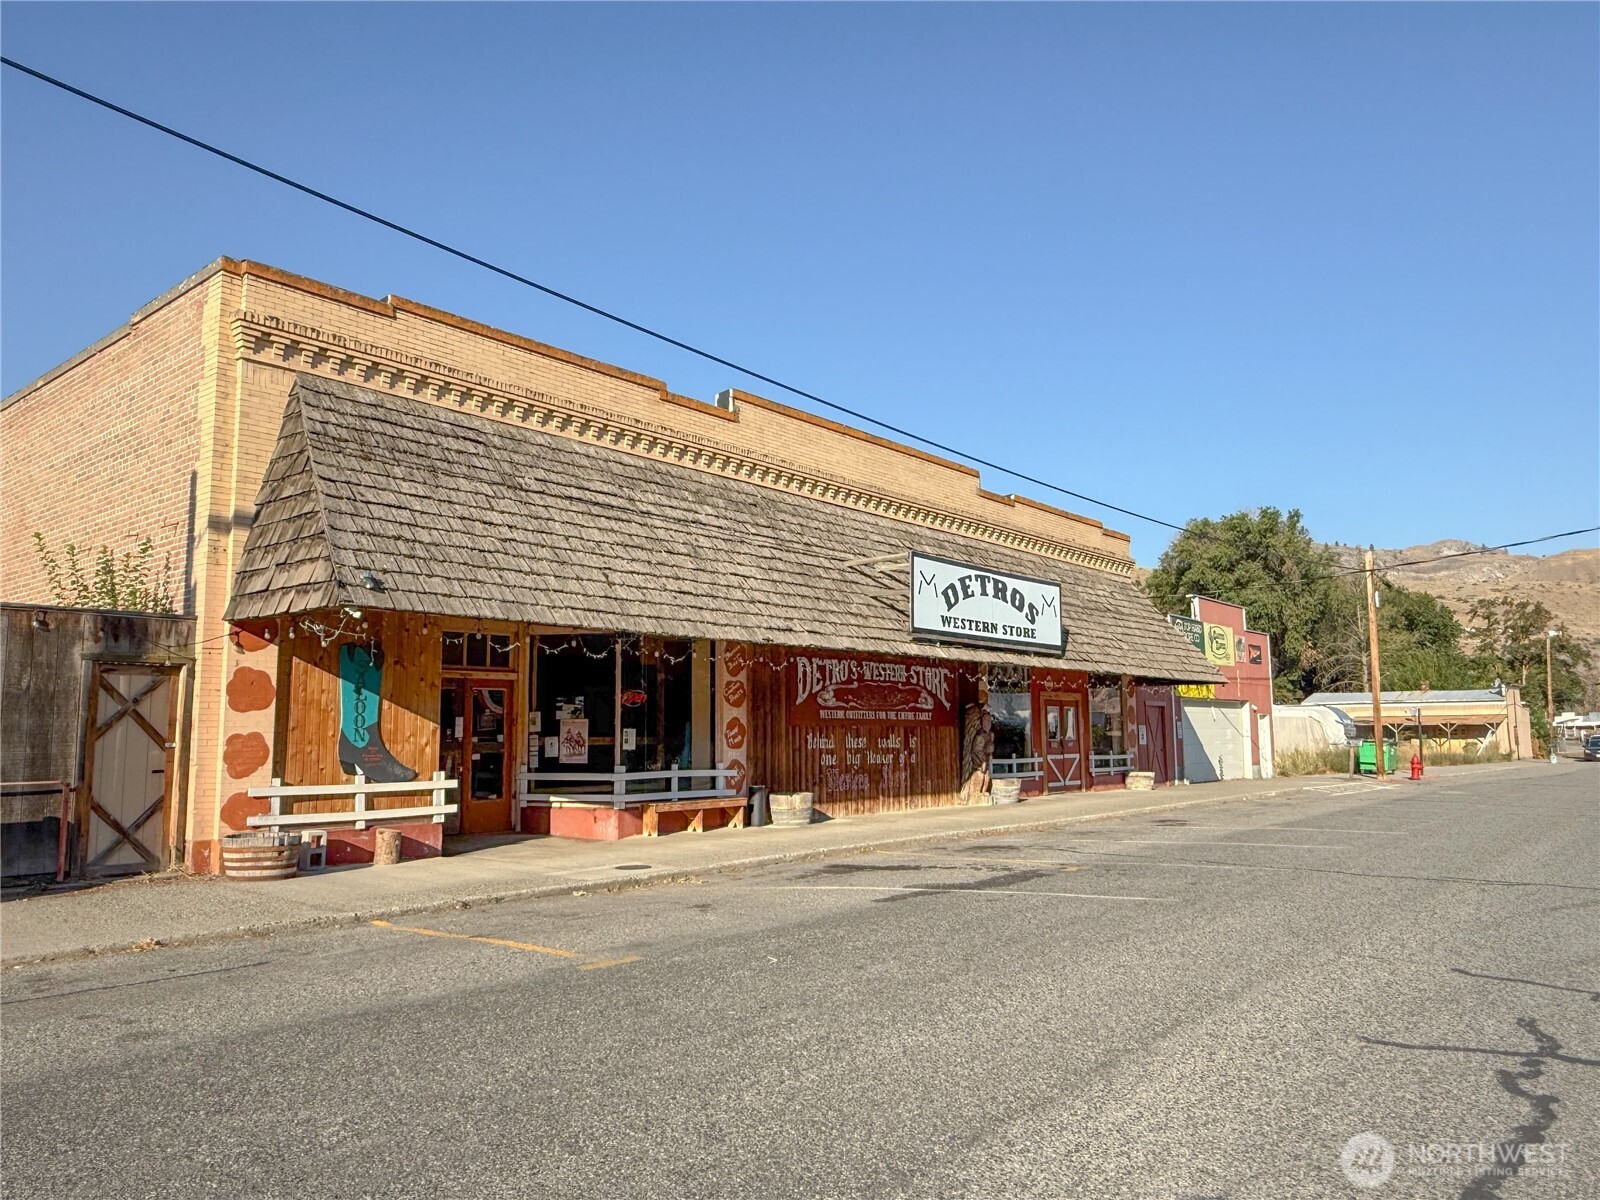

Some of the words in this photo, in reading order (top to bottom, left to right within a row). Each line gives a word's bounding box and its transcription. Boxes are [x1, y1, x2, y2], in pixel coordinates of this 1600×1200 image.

[941, 574, 1039, 625] DETROS
[940, 614, 998, 634] WESTERN
[1002, 624, 1037, 639] STORE
[796, 656, 858, 706] DETRO'S
[862, 661, 907, 682] WESTERN
[910, 665, 950, 711] STORE
[819, 709, 845, 719] WESTERN
[807, 732, 835, 749] Behind
[845, 732, 867, 748] these
[878, 733, 901, 748] walls
[909, 733, 917, 748] is
[820, 753, 837, 766] one
[846, 751, 861, 769] big
